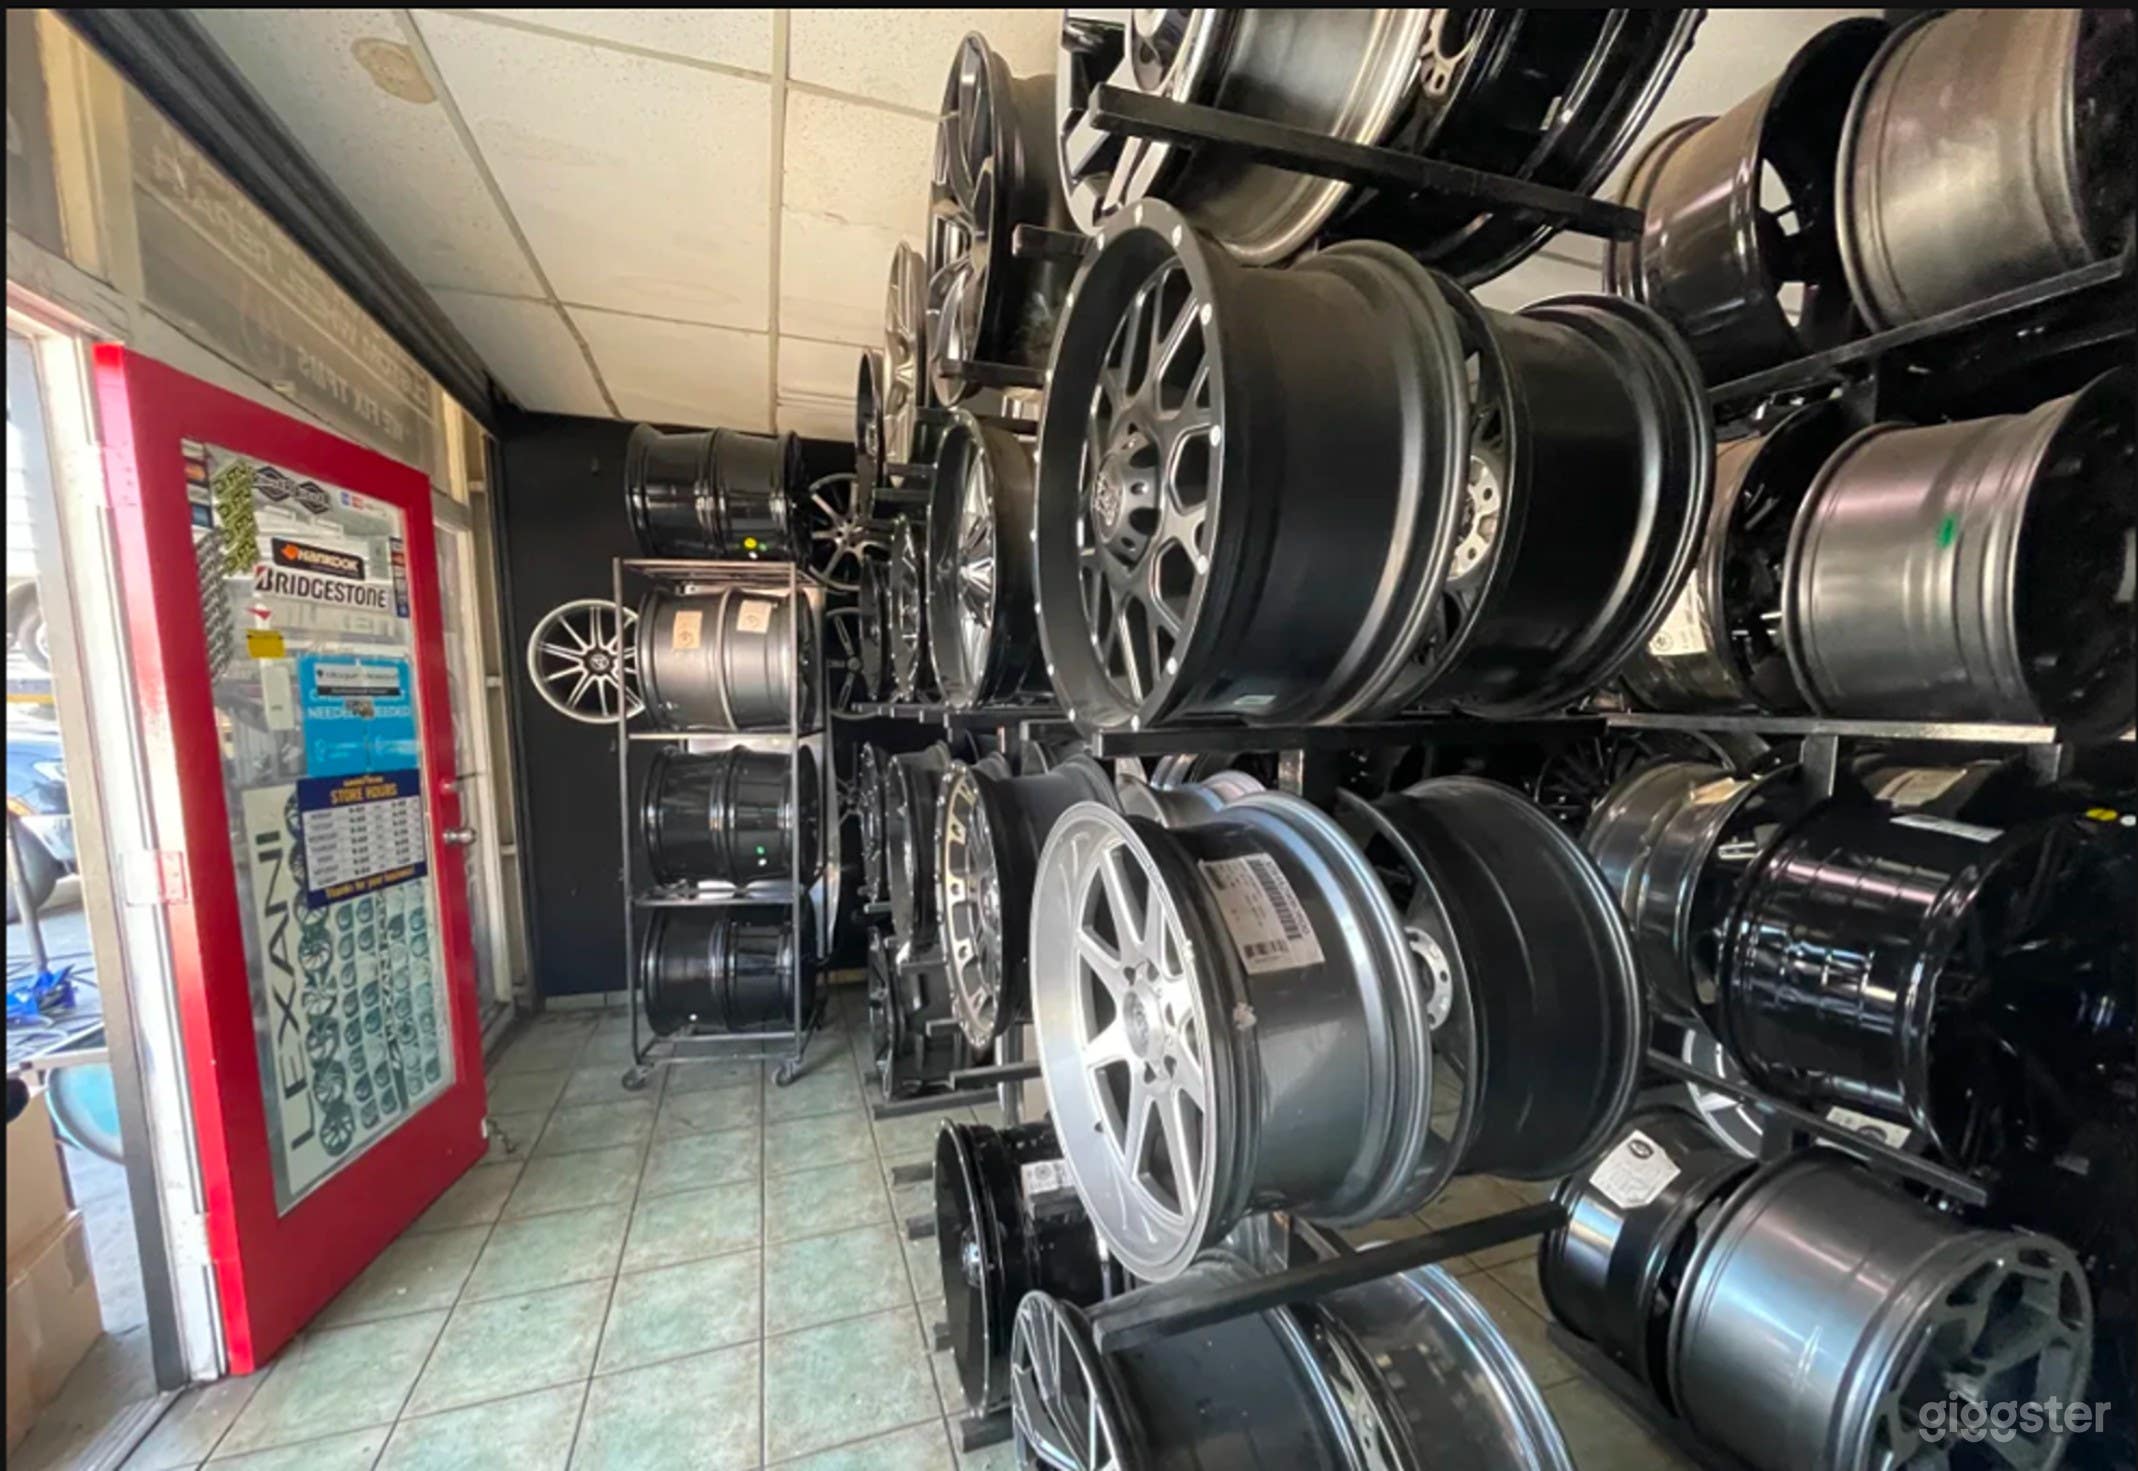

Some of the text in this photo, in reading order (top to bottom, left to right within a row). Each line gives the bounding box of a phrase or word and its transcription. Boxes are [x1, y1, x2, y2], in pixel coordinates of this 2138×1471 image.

[254, 565, 387, 608] BRIDGESTONE
[331, 787, 362, 804] STORE
[255, 830, 315, 1151] LEXANI
